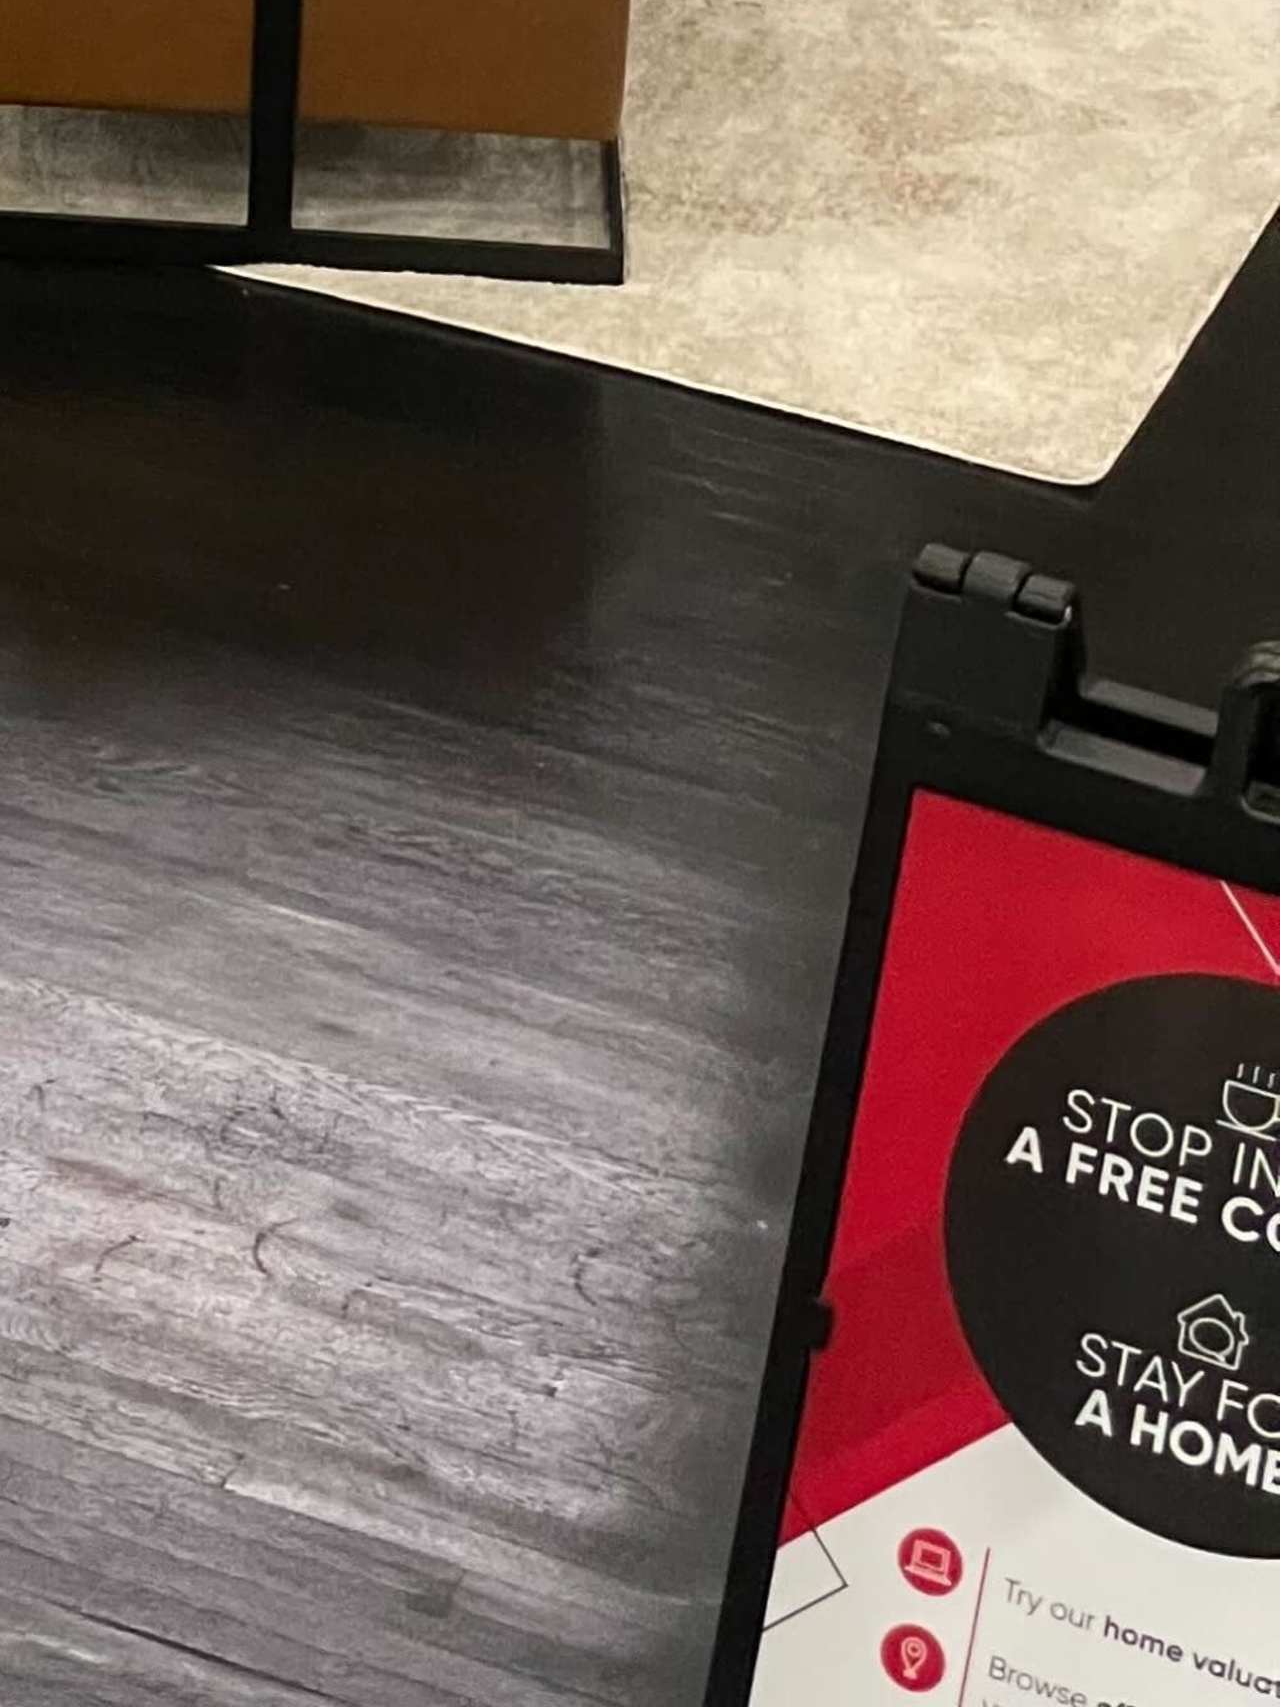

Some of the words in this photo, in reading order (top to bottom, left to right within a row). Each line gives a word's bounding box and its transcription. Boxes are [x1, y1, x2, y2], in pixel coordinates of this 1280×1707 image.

[1005, 1126, 1044, 1174] A
[1065, 1142, 1204, 1225] FREE
[1062, 1088, 1213, 1167] STOP
[1233, 1142, 1280, 1198] IN
[1076, 1333, 1206, 1408] STAY
[1075, 1389, 1113, 1437] A
[1004, 1577, 1044, 1616] Try
[1049, 1601, 1096, 1630] our
[1103, 1614, 1184, 1663] home
[988, 1655, 1088, 1707] Browse
